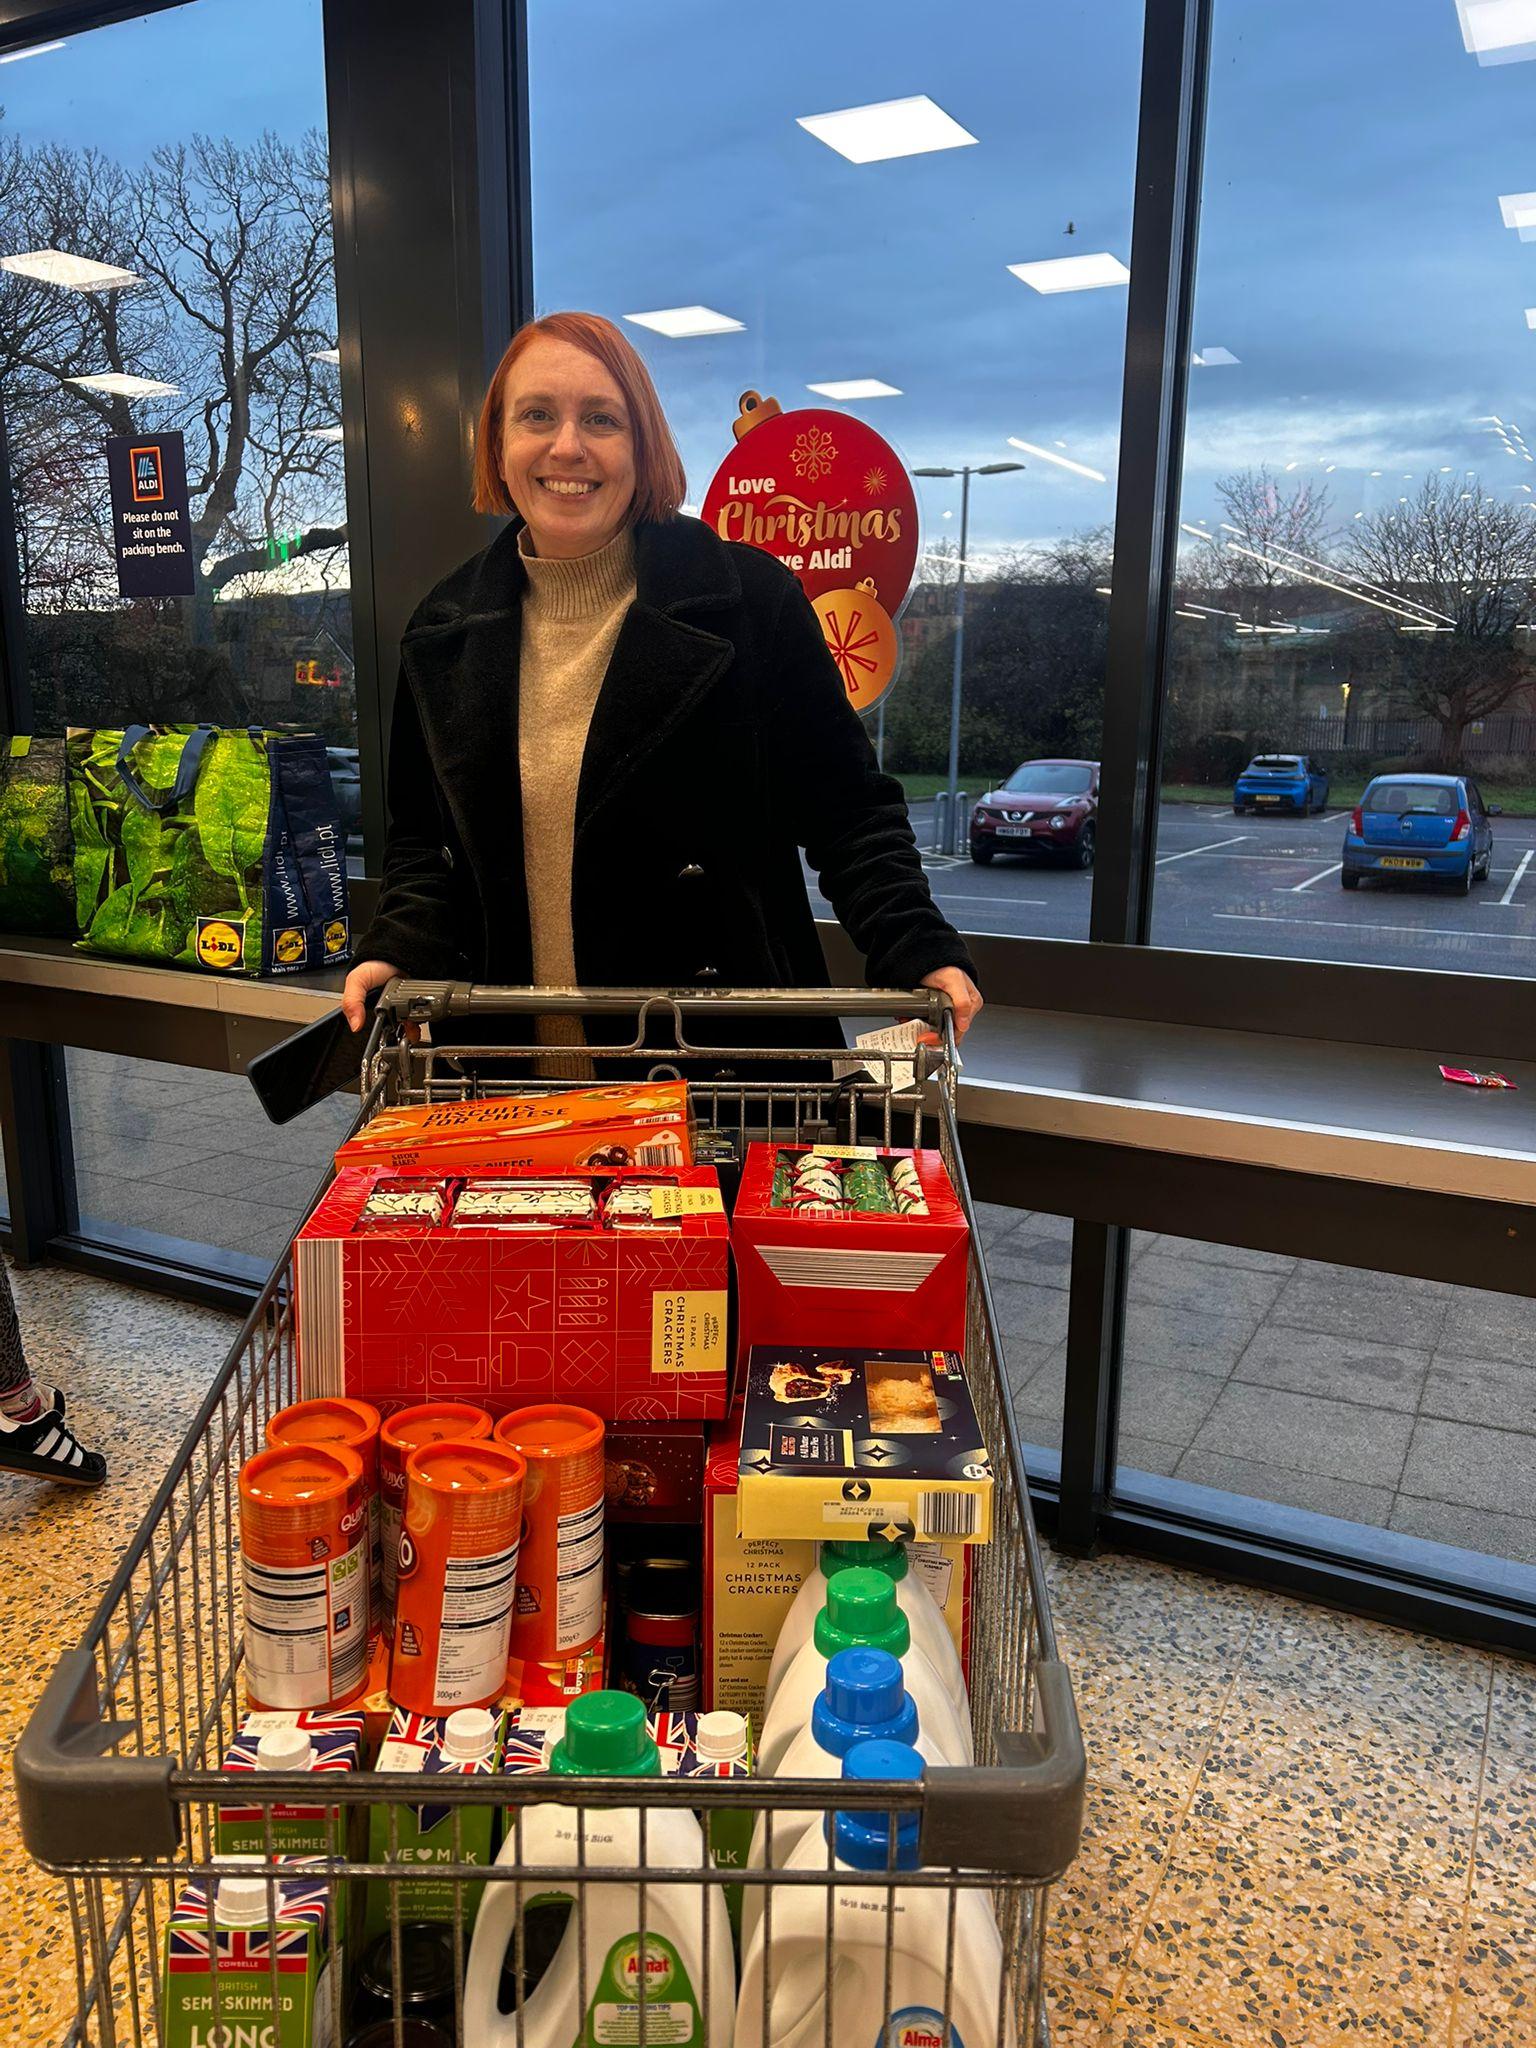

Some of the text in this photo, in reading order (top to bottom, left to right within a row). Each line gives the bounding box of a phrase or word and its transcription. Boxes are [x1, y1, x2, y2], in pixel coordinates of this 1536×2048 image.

[138, 479, 158, 490] ALDI
[729, 476, 776, 495] Love
[122, 509, 179, 524] Please do not
[717, 500, 902, 549] Christmas
[132, 526, 172, 539] sit on the
[122, 542, 185, 558] packing bench.
[808, 546, 852, 570] Aldi
[315, 824, 344, 912] www.lidl.pt
[422, 1116, 468, 1128] FOR
[477, 1107, 569, 1123] CHEESE
[427, 1104, 535, 1121] BISCUITS
[690, 1315, 697, 1324] 12
[664, 1299, 673, 1365] CRACKERS
[676, 1296, 686, 1367] CHRISTMAS
[711, 1316, 719, 1346] PERFECT
[747, 1540, 780, 1548] PERFECT
[725, 1573, 802, 1582] CHRISTMAS
[728, 1585, 799, 1594] CRACKERS
[218, 1982, 258, 1992] BRITISH
